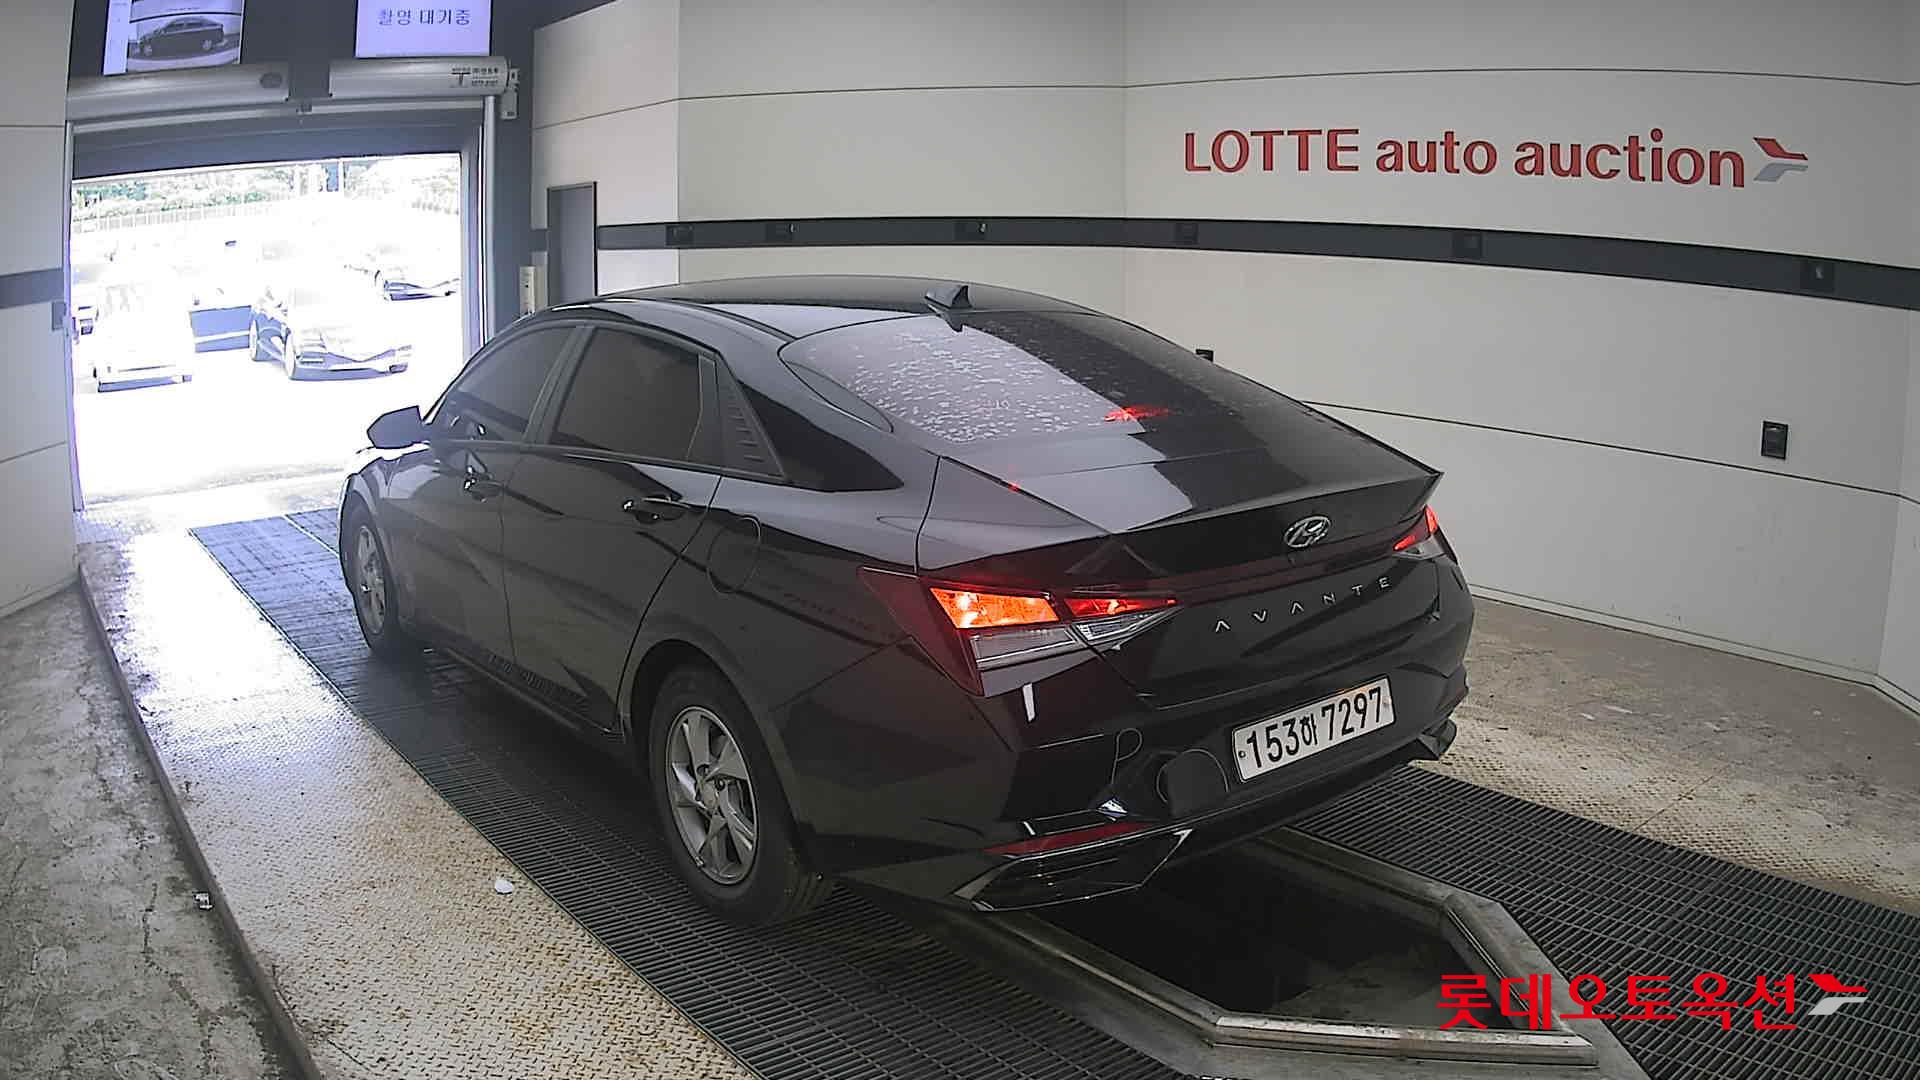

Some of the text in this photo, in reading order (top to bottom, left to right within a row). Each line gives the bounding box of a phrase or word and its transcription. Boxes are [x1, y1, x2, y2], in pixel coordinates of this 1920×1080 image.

[419, 8, 471, 26] 대기중
[1185, 128, 1745, 188] LOTTE auto auction
[1215, 577, 1391, 632] AVANTE
[1321, 686, 1383, 741] 7297
